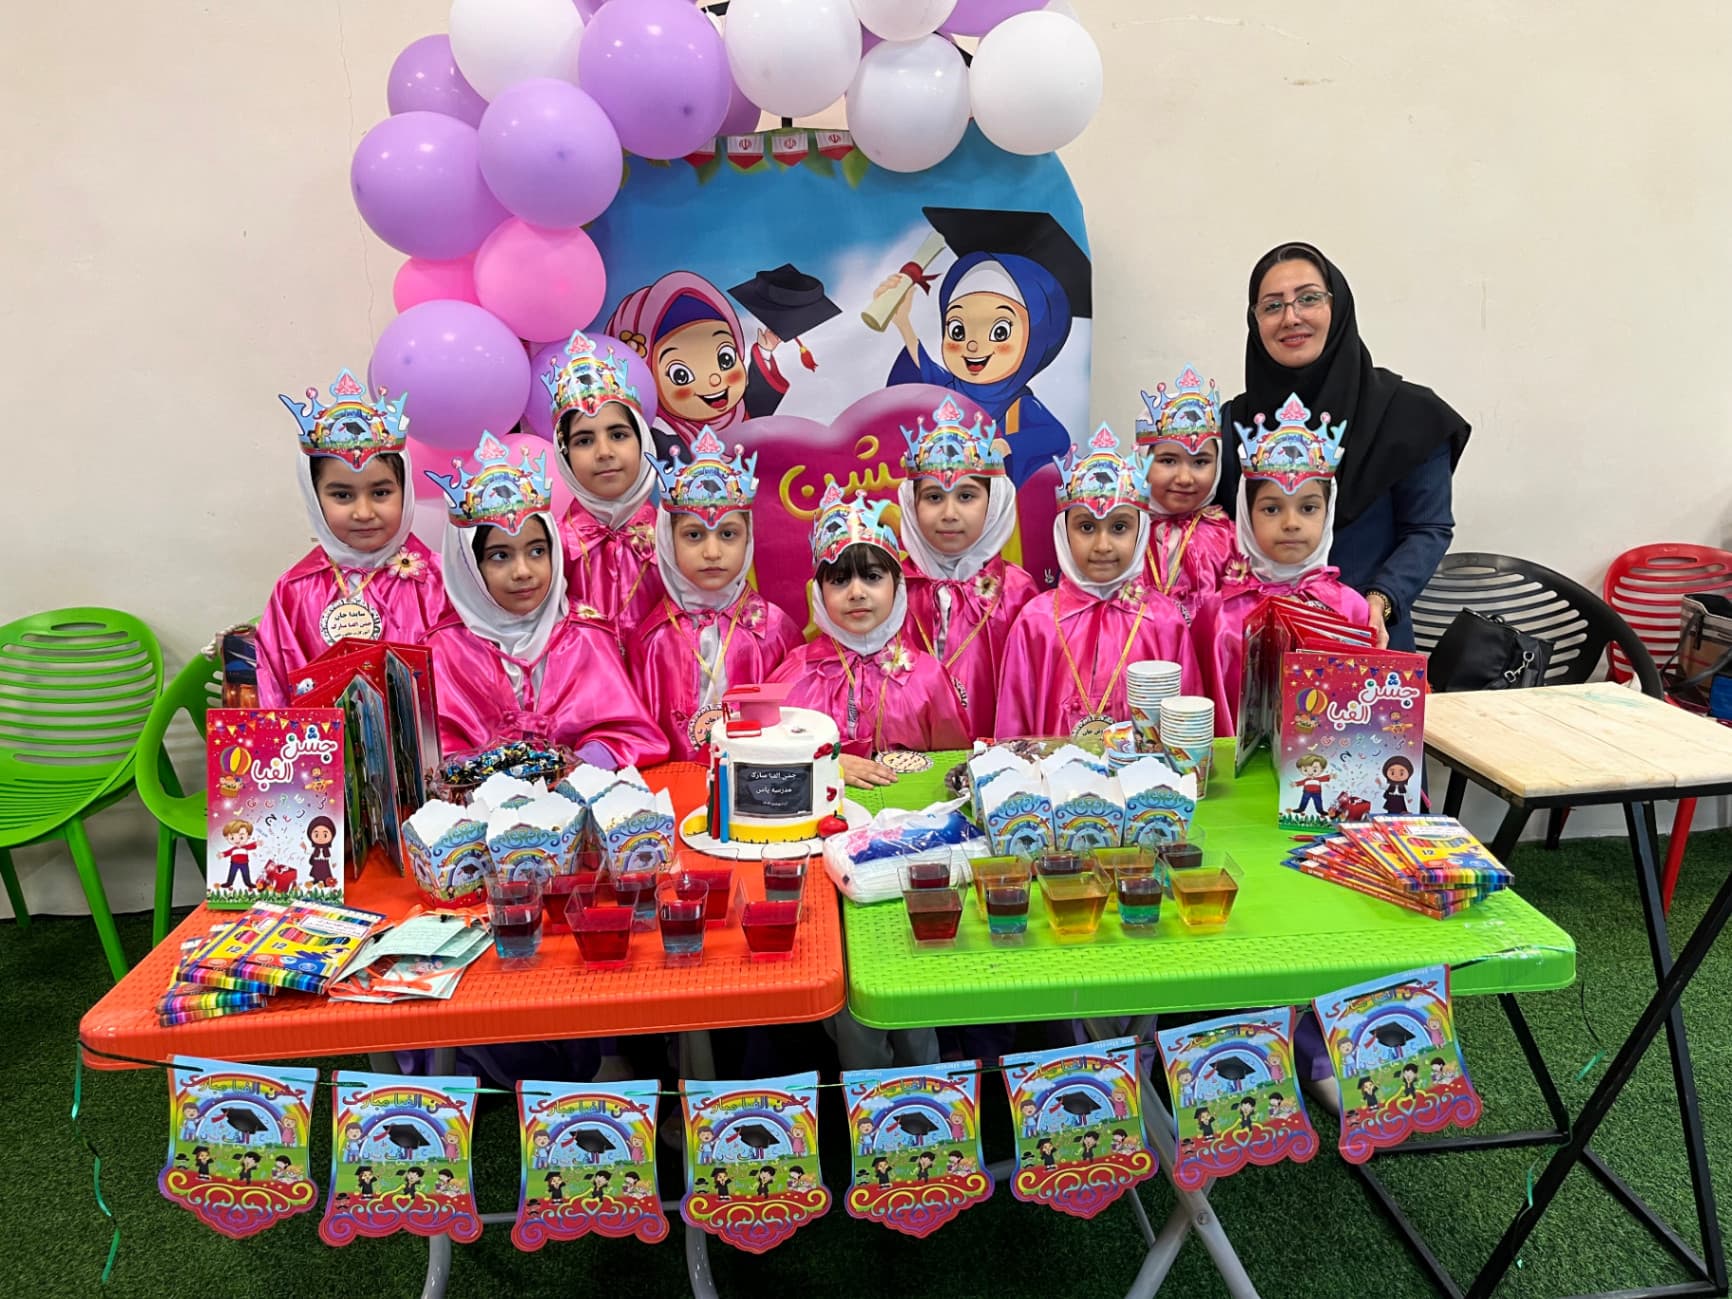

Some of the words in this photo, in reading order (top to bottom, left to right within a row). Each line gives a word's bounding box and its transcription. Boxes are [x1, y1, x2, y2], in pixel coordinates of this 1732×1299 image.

[779, 435, 907, 520] شن
[1360, 672, 1419, 708] جشن
[1327, 701, 1370, 730] الفبا
[281, 725, 337, 763] جشن
[252, 758, 292, 791] الفبا
[1402, 980, 1438, 1000] جشن
[1059, 1056, 1088, 1075] الفبا
[1092, 1052, 1129, 1071] جشن
[232, 1078, 260, 1095] الفبا
[264, 1083, 307, 1101] جشن
[899, 1076, 927, 1095] الفبا
[931, 1074, 969, 1093] جشن
[394, 1092, 422, 1108] الفبا
[426, 1095, 467, 1113] جشن
[578, 1099, 606, 1114] الفبا
[611, 1099, 650, 1119] جشن
[742, 1095, 769, 1110] الفبا
[774, 1093, 811, 1113] جشن
